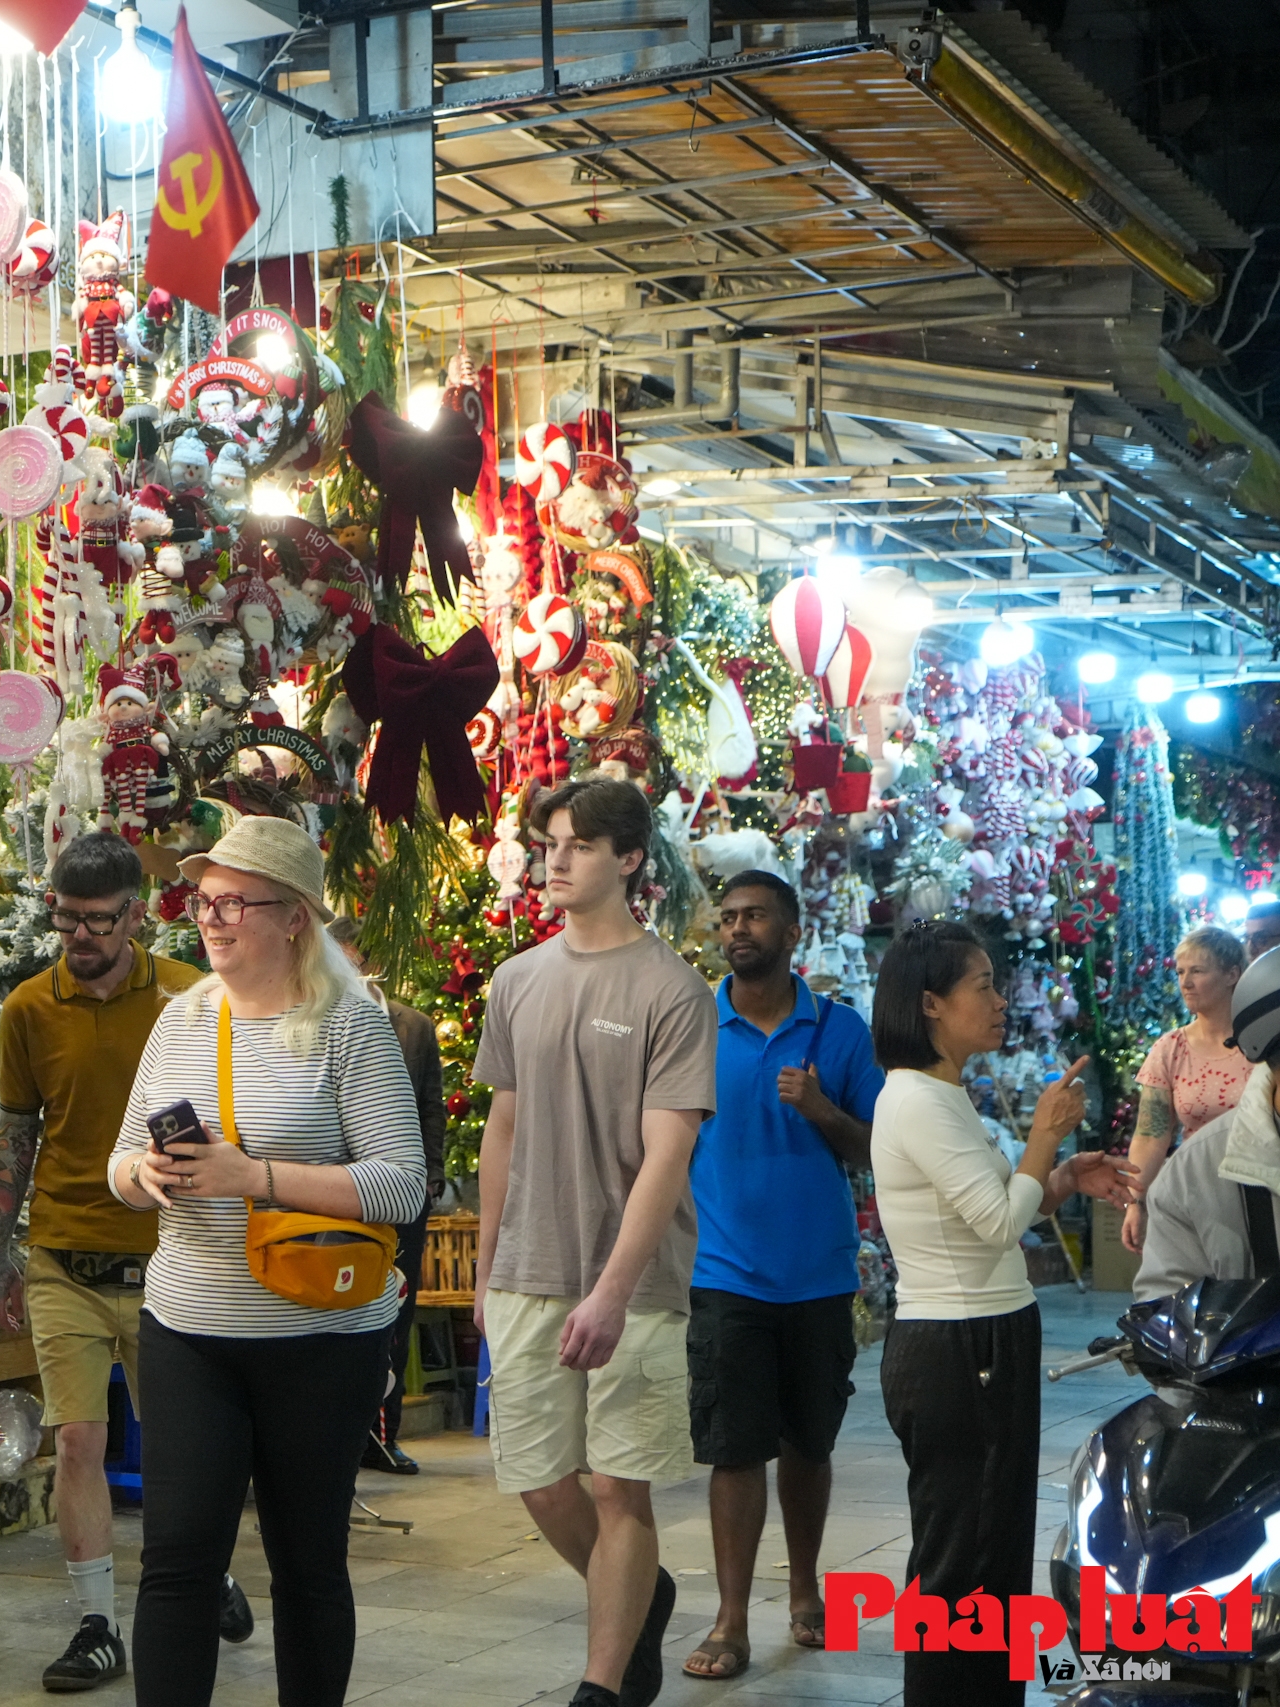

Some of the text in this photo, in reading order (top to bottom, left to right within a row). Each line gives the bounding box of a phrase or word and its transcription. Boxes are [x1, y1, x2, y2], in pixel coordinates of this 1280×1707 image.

[213, 312, 287, 355] LT IT SNOW
[208, 361, 260, 384] CHRISTMAS
[259, 519, 288, 535] HO!
[304, 528, 330, 552] HO!
[206, 728, 327, 771] MERRY CHRISTMAS
[591, 1018, 633, 1034] AUTONOMY
